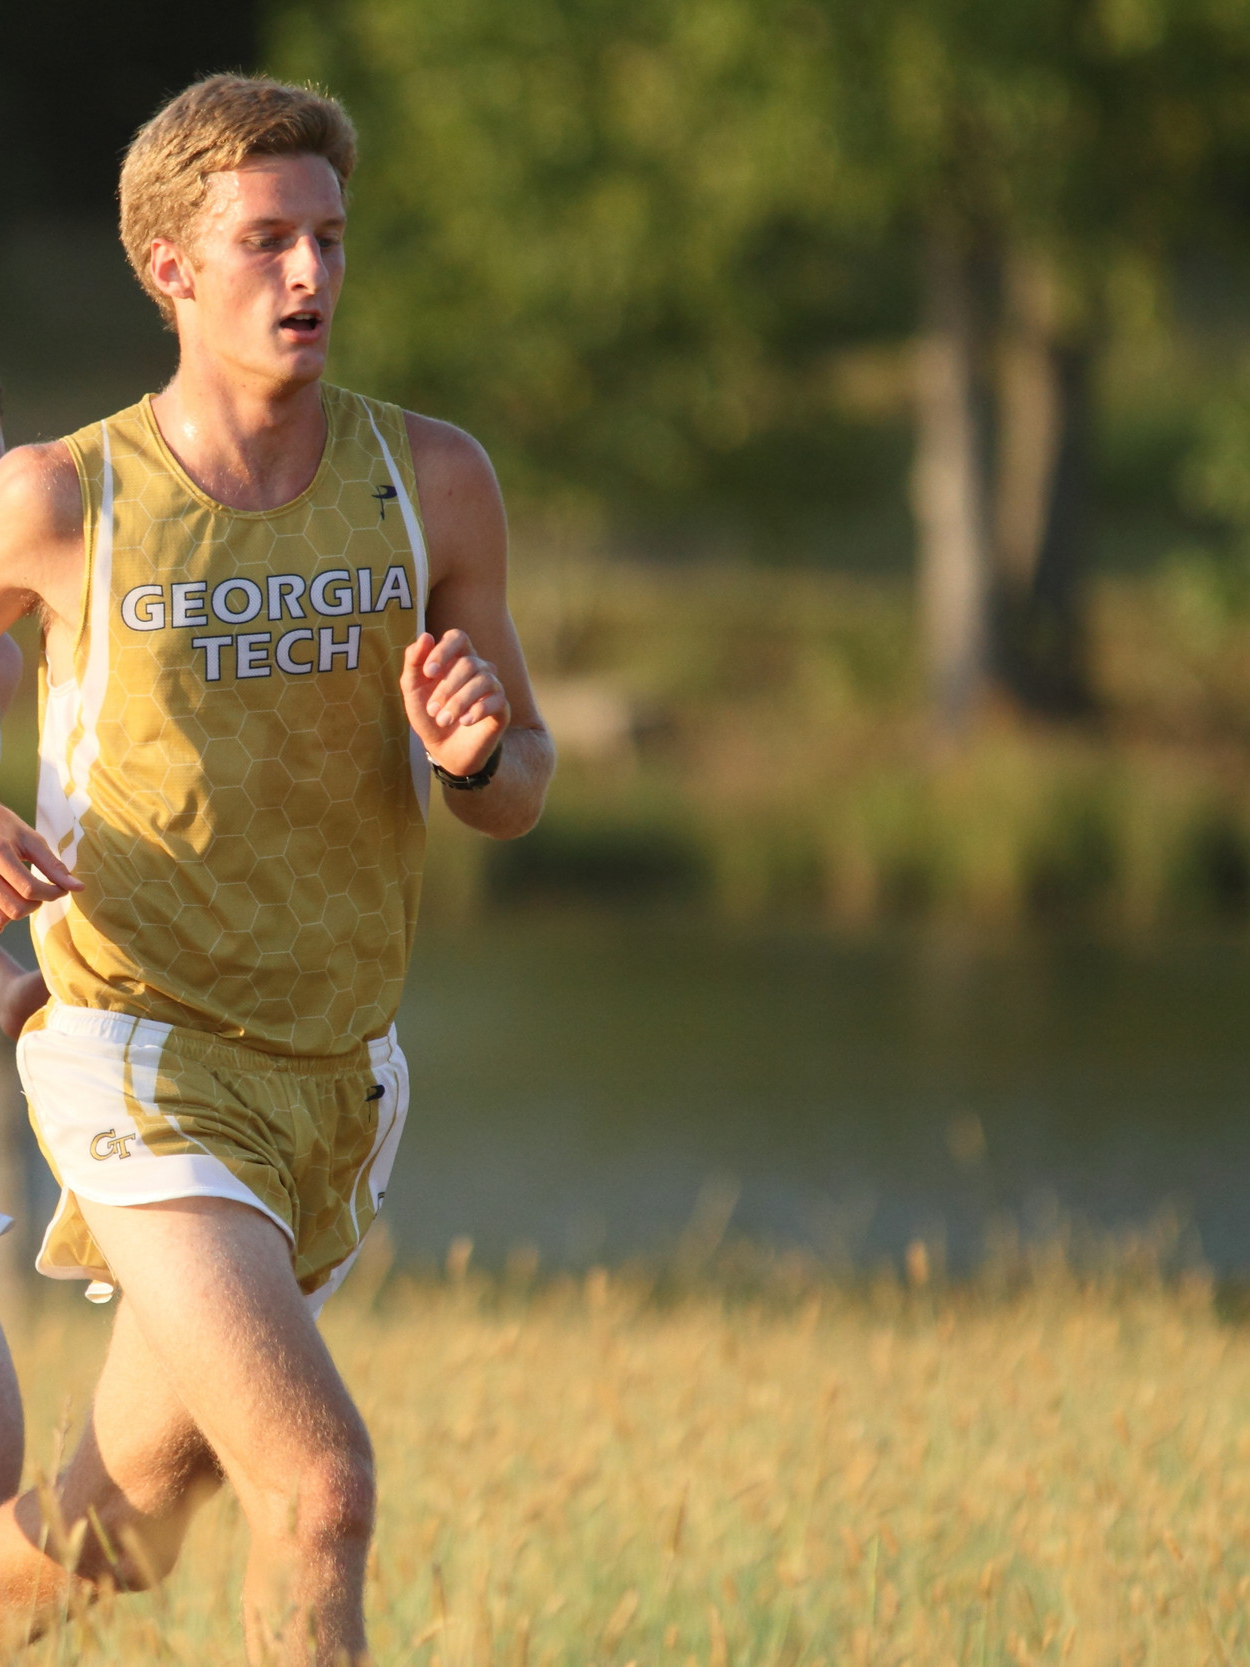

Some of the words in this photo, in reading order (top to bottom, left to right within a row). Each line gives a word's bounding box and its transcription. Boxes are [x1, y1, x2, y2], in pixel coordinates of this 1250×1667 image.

[121, 565, 414, 632] GEORGIA
[191, 624, 363, 682] TECH
[90, 1128, 136, 1161] GT
